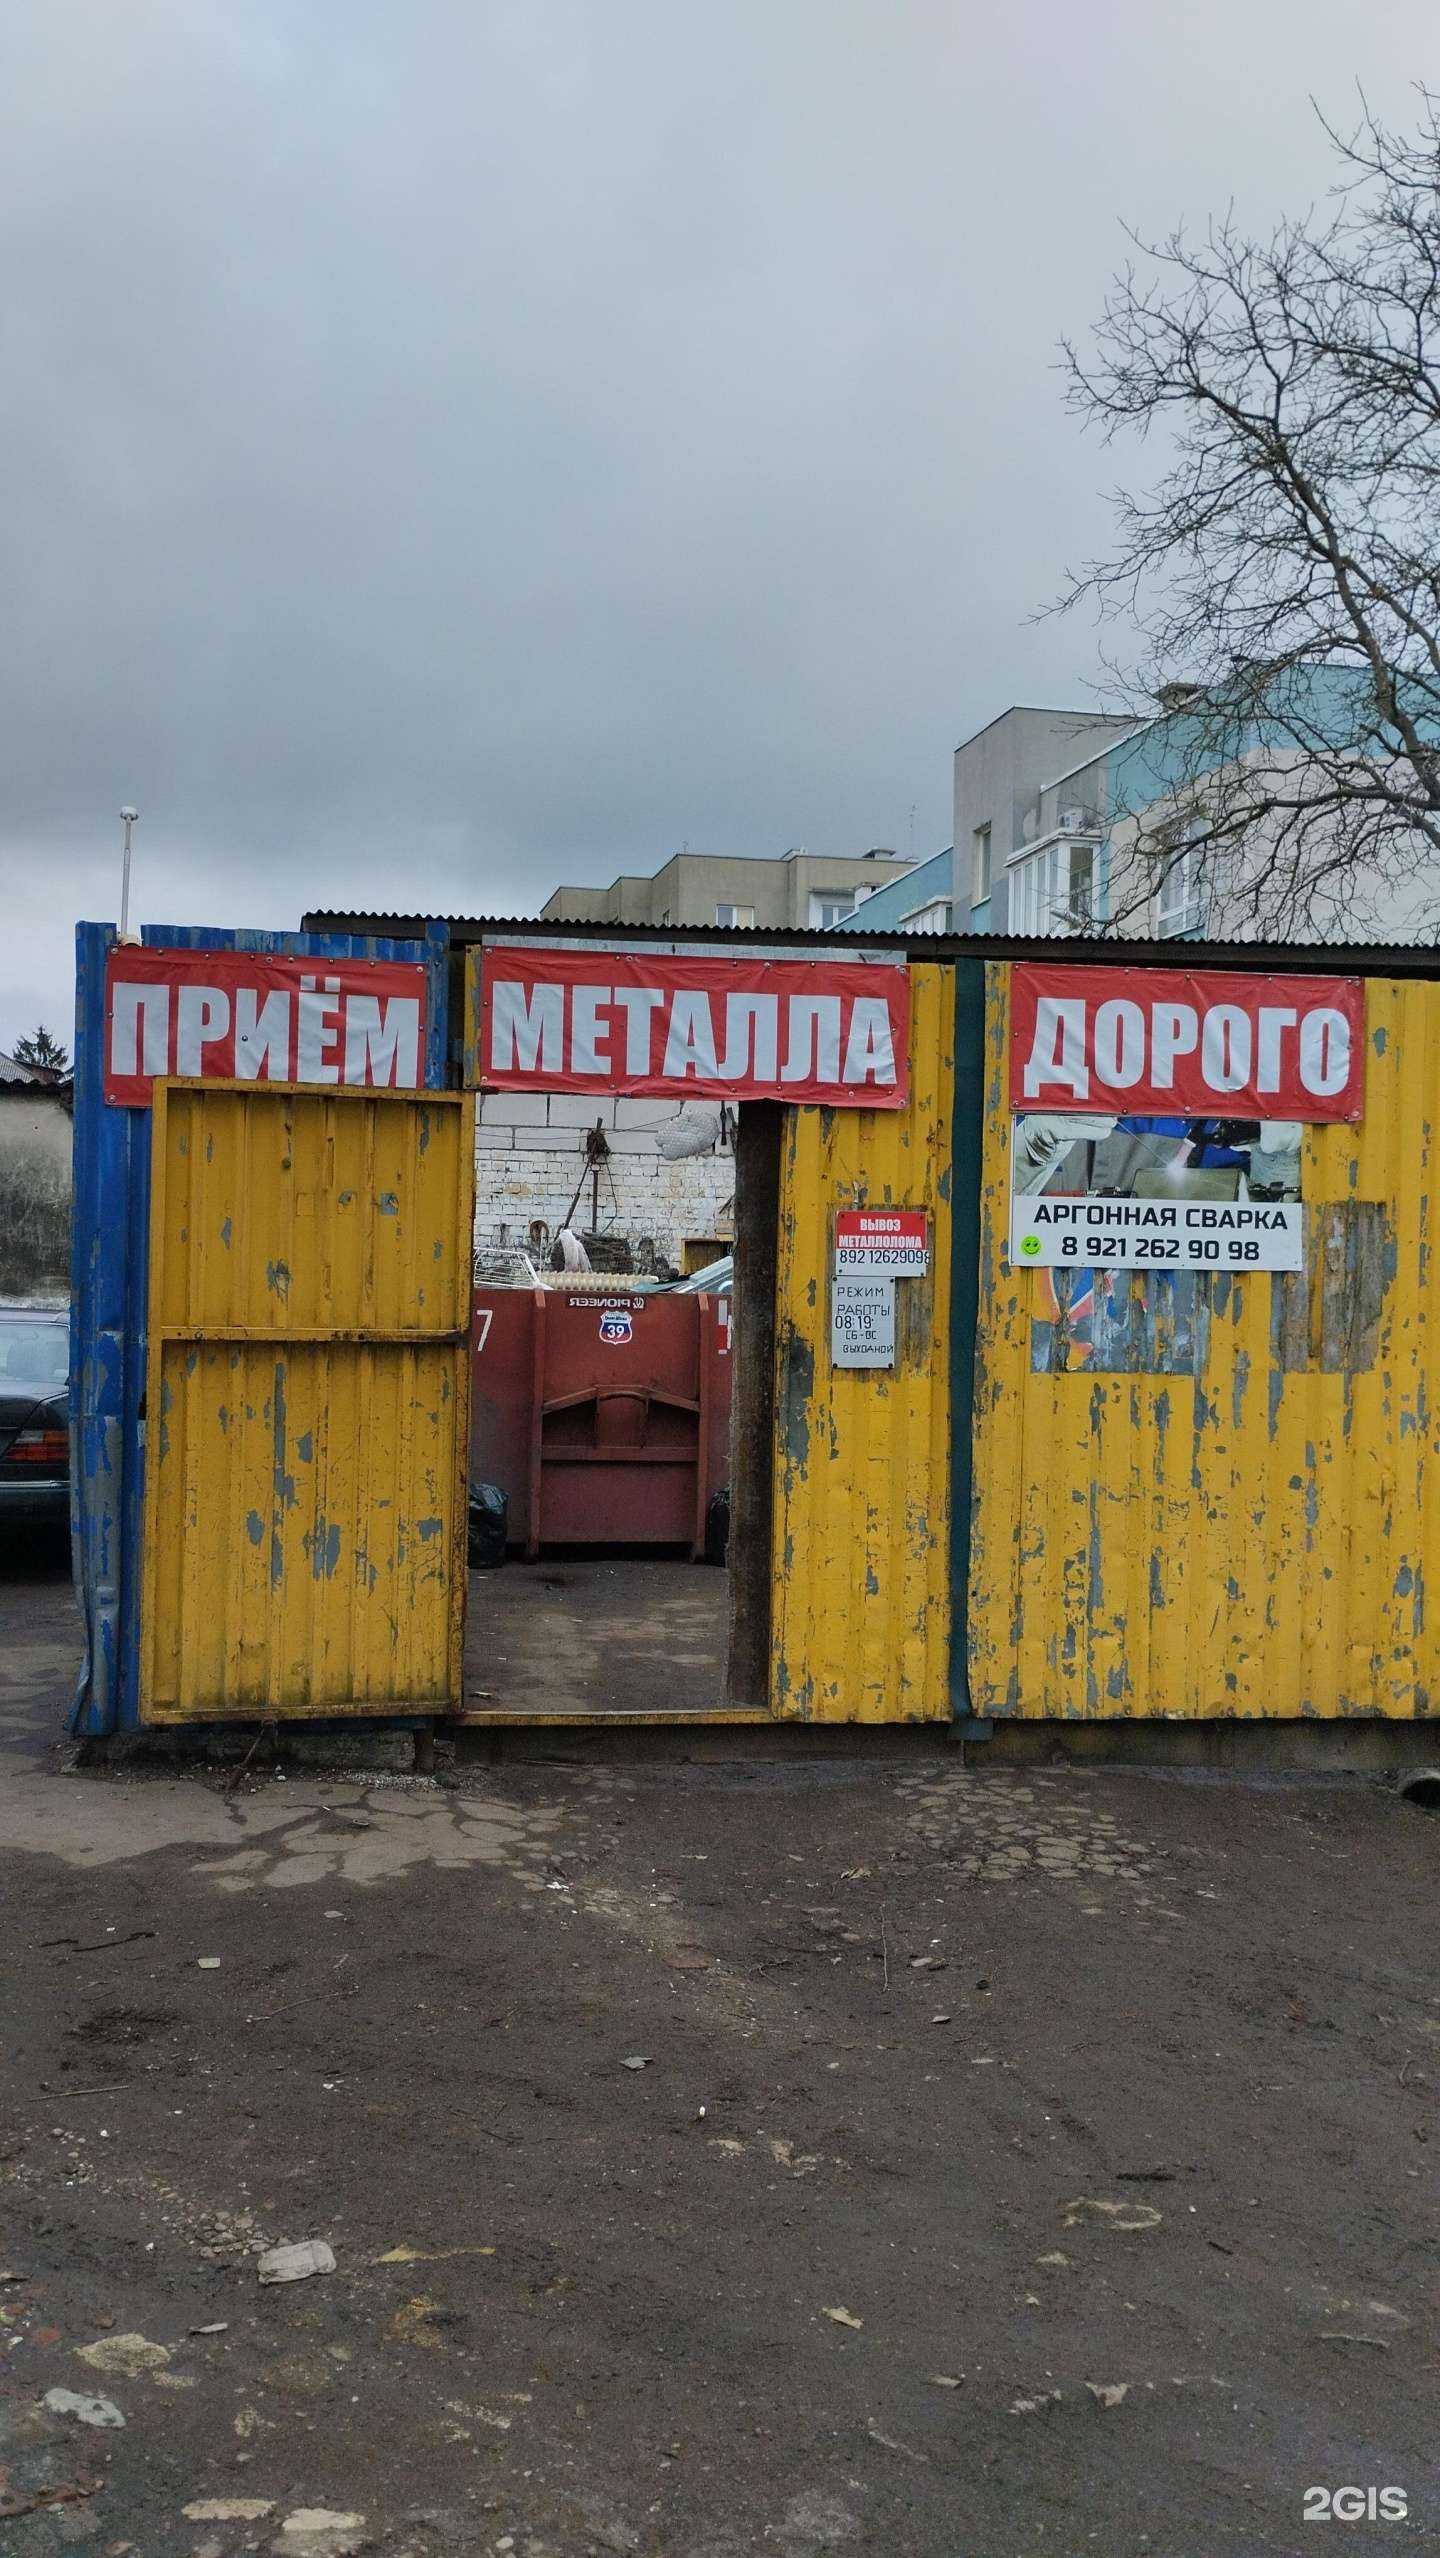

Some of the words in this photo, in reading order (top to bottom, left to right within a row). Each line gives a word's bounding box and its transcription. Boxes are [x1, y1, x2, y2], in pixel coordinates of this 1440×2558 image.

[111, 975, 420, 1089] ПРИЁМ
[491, 981, 897, 1085] МЕТАЛЛА
[1023, 997, 1350, 1100] ДОРОГО
[860, 1218, 901, 1232] ВЫВОЗ
[1034, 1203, 1177, 1227] АРГОННАЯ
[1185, 1208, 1288, 1230] СВАРКА
[838, 1234, 923, 1249] МЕТАЛЛОЛОМА
[1061, 1236, 1078, 1256] 8
[1086, 1236, 1126, 1257] 921
[1135, 1238, 1180, 1258] 262
[1188, 1240, 1220, 1260] 90
[1228, 1241, 1260, 1261] 98
[837, 1287, 884, 1298] РЕЖИМ
[837, 1304, 890, 1316] РАБОТЫ
[607, 1324, 625, 1339] 39
